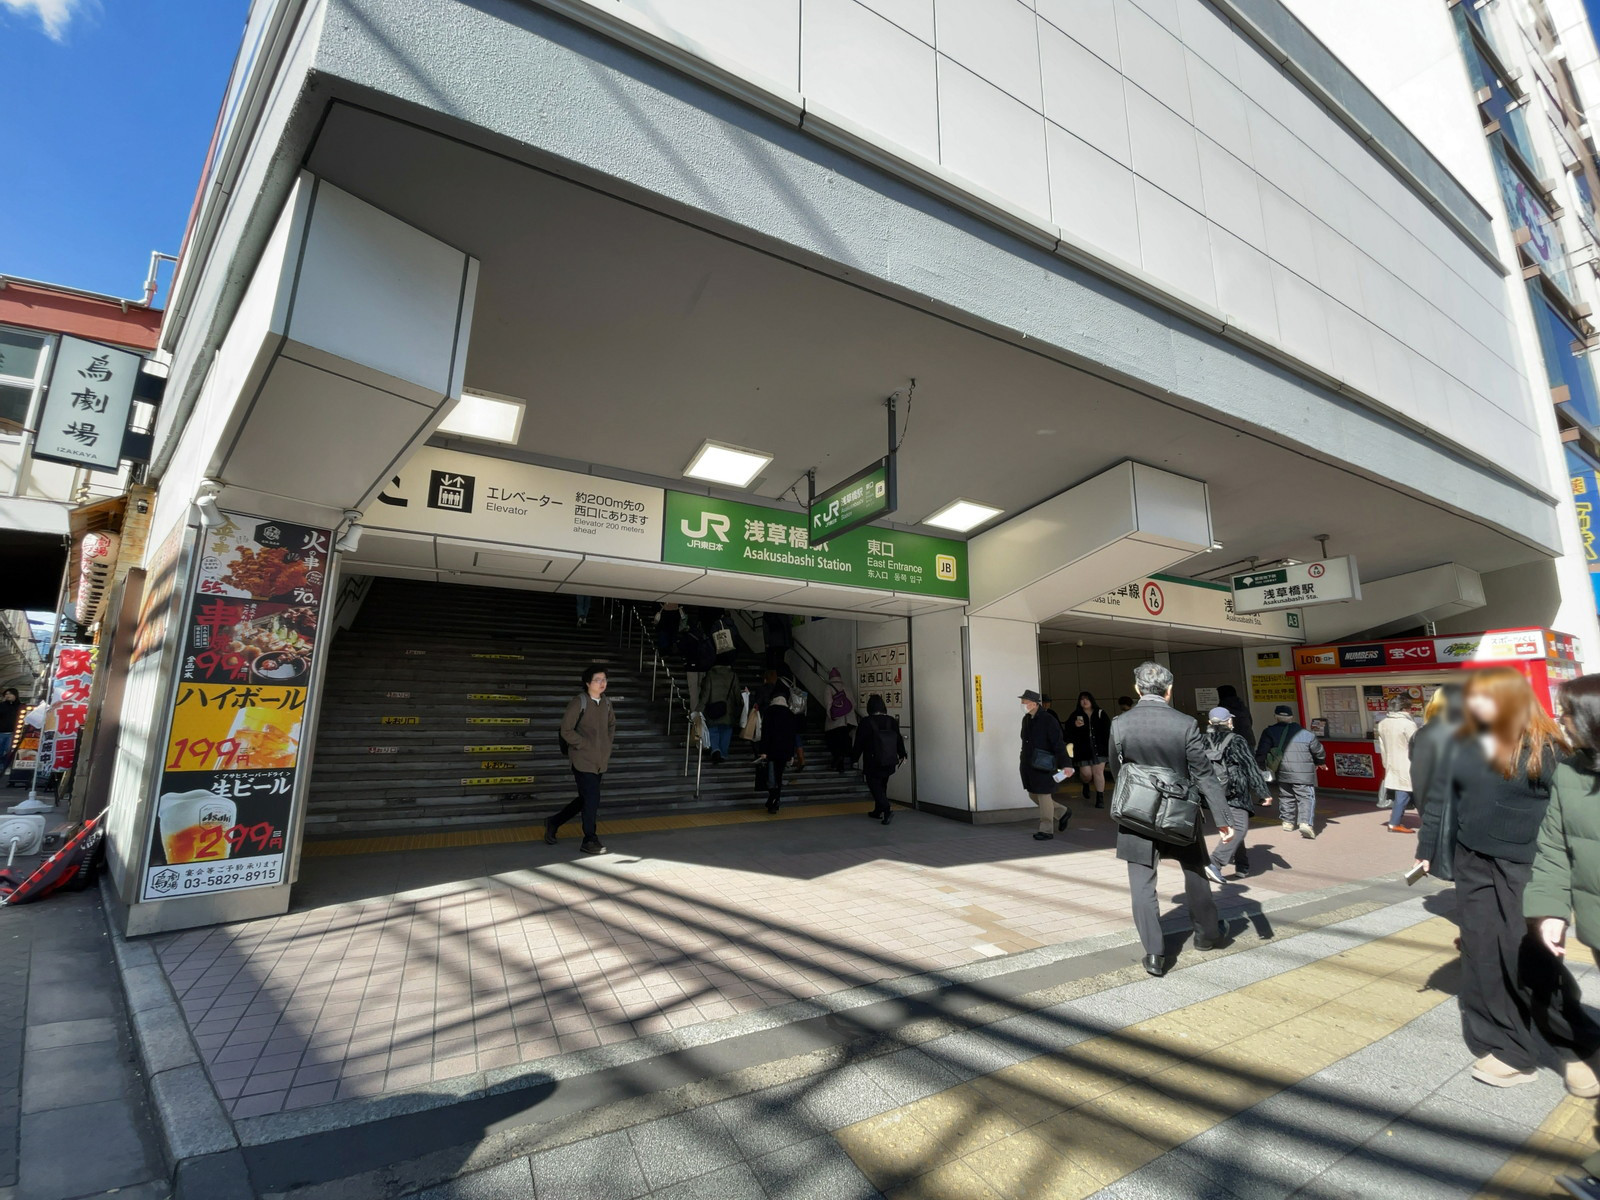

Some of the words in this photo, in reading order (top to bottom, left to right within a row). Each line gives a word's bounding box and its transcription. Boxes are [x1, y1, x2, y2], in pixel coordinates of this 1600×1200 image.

[56, 447, 98, 459] IZAKAYA
[487, 487, 563, 507] エレベーター
[575, 491, 645, 513] 約200m先の
[486, 502, 528, 516] Elevator
[574, 504, 648, 526] 西口にあります
[823, 500, 839, 522] JR
[573, 526, 597, 535] ahead
[574, 517, 604, 528] Elevator
[605, 522, 620, 530] 200
[620, 524, 645, 534] meters
[681, 511, 730, 543] JR
[743, 518, 829, 553] 浅草橋
[687, 539, 724, 552] JR東日本
[867, 539, 894, 558] 東口
[743, 546, 815, 568] Asakusabashi
[817, 556, 852, 573] Station
[867, 557, 886, 568] East
[887, 560, 923, 574] Entrance
[941, 562, 952, 573] JB
[1108, 583, 1140, 599] 草線
[1150, 587, 1156, 597] A
[1263, 583, 1315, 600] 浅草橋駅
[1107, 596, 1121, 605] Line
[1149, 597, 1159, 608] 16
[1263, 594, 1304, 606] Asakusabashi
[1288, 616, 1298, 627] A3
[857, 650, 905, 664] エレベーター
[1345, 650, 1379, 660] NUMBERS
[1389, 646, 1431, 660] 宝くじ
[860, 671, 892, 684] は西口に
[176, 687, 306, 711] ハイボール
[211, 777, 291, 797] 生ビール
[202, 811, 231, 823] Asahi
[184, 868, 276, 889] 03-5829-8915
